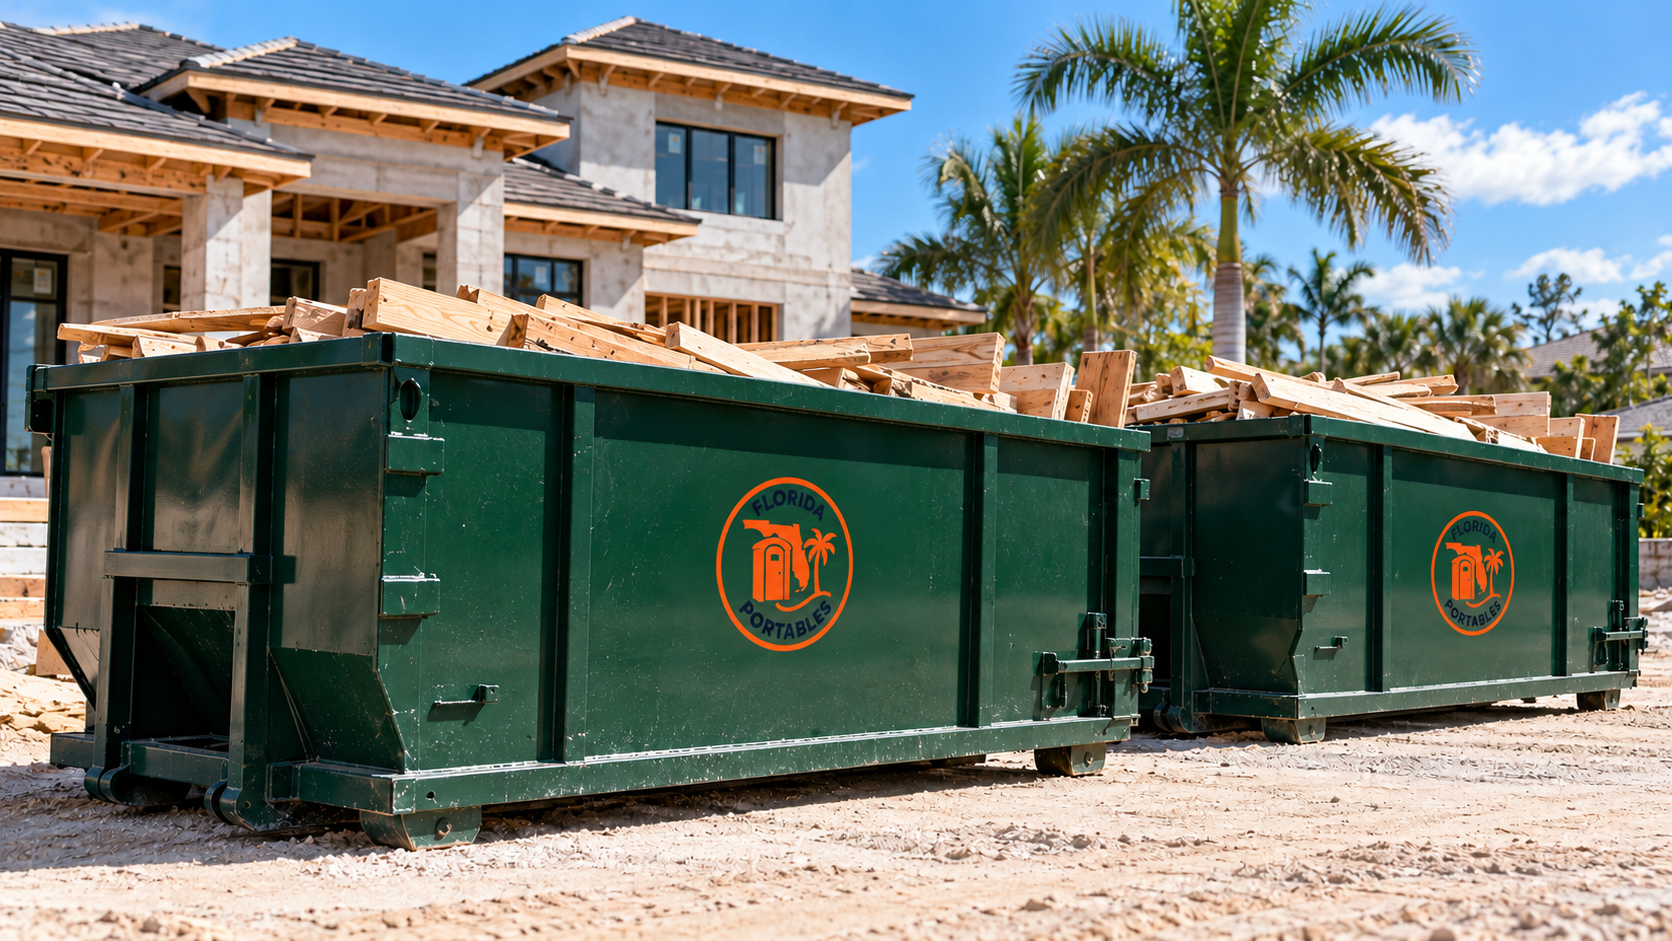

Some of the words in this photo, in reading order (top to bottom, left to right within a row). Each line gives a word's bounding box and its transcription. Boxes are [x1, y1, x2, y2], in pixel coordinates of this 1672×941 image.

[751, 489, 825, 521] FLORIDA
[1450, 519, 1497, 544] FLORIDA
[738, 600, 832, 640] PORTABLES
[1444, 599, 1501, 627] PORTABLES
